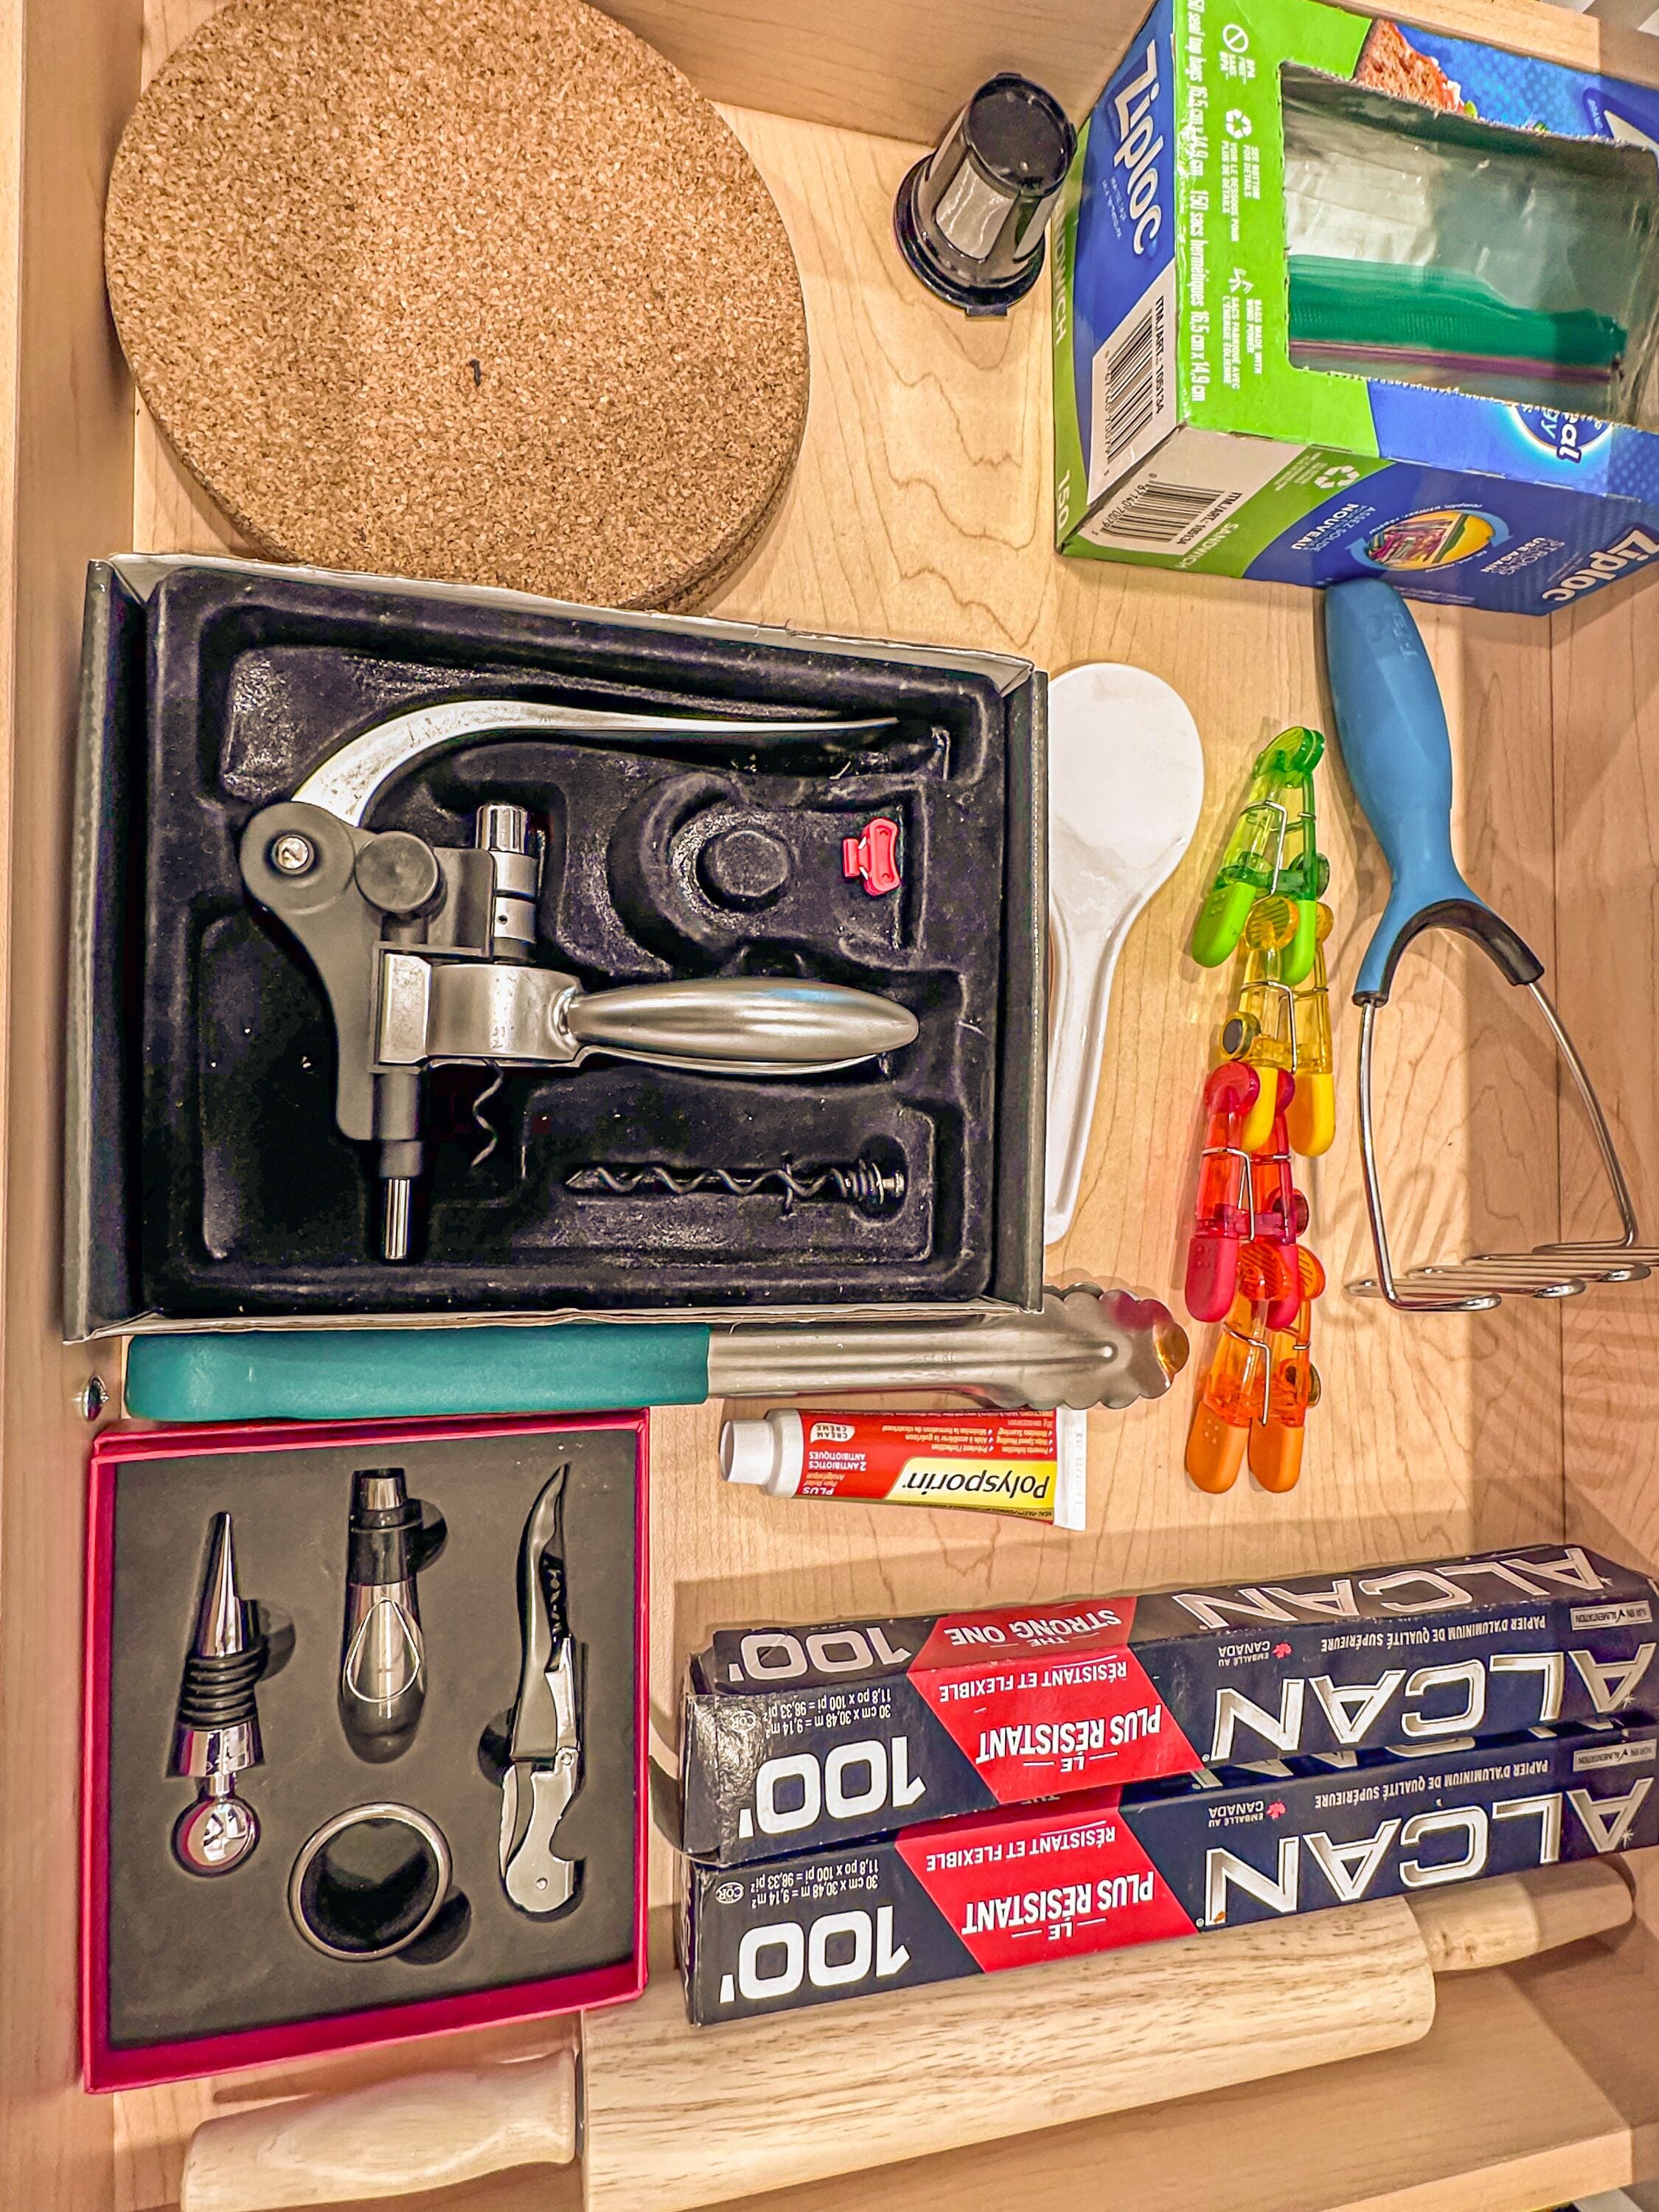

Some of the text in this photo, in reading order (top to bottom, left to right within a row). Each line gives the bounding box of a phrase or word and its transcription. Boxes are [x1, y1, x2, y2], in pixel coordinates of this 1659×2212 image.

[1188, 12, 1206, 37] seal
[1185, 37, 1203, 54] top
[1185, 56, 1206, 82] bags
[1189, 109, 1204, 125] cm
[1114, 39, 1164, 254] Ziploc
[1221, 140, 1230, 161] PLUS
[1222, 164, 1231, 175] DE
[1243, 144, 1252, 198] FOR DETAILS
[1251, 146, 1261, 200] SEE BOTTOM
[1189, 189, 1209, 211] 150
[1230, 142, 1239, 241] VOIR LE DESSOUS POUR
[1190, 212, 1203, 237] sacs
[1186, 240, 1209, 307] hermétiques
[1231, 296, 1240, 320] SACS
[1189, 310, 1209, 333] 16,5
[1191, 335, 1204, 350] cm
[1246, 323, 1254, 354] POWER
[1254, 299, 1262, 375] BAGS MADE WITH
[1191, 352, 1204, 360] x
[1189, 361, 1210, 384] 14,9
[1231, 365, 1241, 390] AVEC
[1155, 363, 1164, 414] 105134
[1192, 385, 1205, 401] cm
[1057, 467, 1070, 532] 150
[1121, 484, 1146, 508] 67140
[1102, 505, 1125, 528] 70079
[1291, 504, 1359, 551] NOUVEAU
[1342, 506, 1376, 529] ASSEZ
[1177, 522, 1206, 545] 105134
[1312, 528, 1347, 552] SOLIDE
[1175, 522, 1239, 569] SANDWICH
[1499, 538, 1565, 574] STRONG
[1542, 529, 1659, 602] Ziploc
[809, 1451, 866, 1461] ANTIBIOTIQUES
[809, 1460, 866, 1471] 2 ANTIBIOTICS
[802, 1486, 835, 1495] PLUS
[905, 1470, 1050, 1499] Polysporin
[1172, 1548, 1603, 1629] ALCAN
[943, 1608, 1122, 1646] STRONG ONE
[1575, 1611, 1616, 1624] ALIMENTATION
[1026, 1636, 1070, 1647] THE
[1321, 1615, 1545, 1652] PAPIER D'ALUMINIUM DE QUALITÉ SUPÉRIEURE
[727, 1627, 912, 1682] 100'
[1217, 1640, 1270, 1658] CANADA
[1217, 1652, 1270, 1666] EMBALLÉ AU
[938, 1660, 1127, 1703] RÉSISTANT ET FLEXIBLE
[817, 1697, 827, 1711] pi
[829, 1694, 846, 1711] 100
[857, 1690, 870, 1703] po
[871, 1686, 892, 1703] 11,8
[1210, 1642, 1657, 1761] ALCAN
[779, 1700, 807, 1719] 98,33
[813, 1714, 824, 1725] m
[824, 1709, 852, 1728] 30,48
[860, 1705, 877, 1718] cm
[878, 1703, 891, 1719] 30
[782, 1717, 804, 1735] 9,14
[975, 1704, 1162, 1764] PLUS RÉSISTANT
[1060, 1755, 1085, 1773] LE
[738, 1736, 927, 1839] 100'
[1315, 1759, 1548, 1809] PAPIER D'ALUMINIUM DE QUALITÉ SUPÉRIEURE
[1208, 1800, 1265, 1819] CANADA
[1208, 1812, 1264, 1828] EMBALLÉ AU
[925, 1826, 1116, 1872] RÉSISTANT ET FLEXIBLE
[1204, 1777, 1654, 1926] ALCAN
[804, 1868, 815, 1882] pi
[815, 1865, 834, 1881] 100
[844, 1859, 857, 1874] po
[858, 1857, 879, 1874] 11,8
[768, 1871, 794, 1890] 98,33
[800, 1885, 810, 1896] m
[811, 1880, 838, 1898] 30,48
[848, 1877, 864, 1890] cm
[865, 1874, 879, 1890] 30
[768, 1888, 790, 1905] 9,14
[961, 1870, 1154, 1935] PLUS RÉSISTANT
[1048, 1921, 1073, 1941] LE
[719, 1905, 911, 2003] 100'
